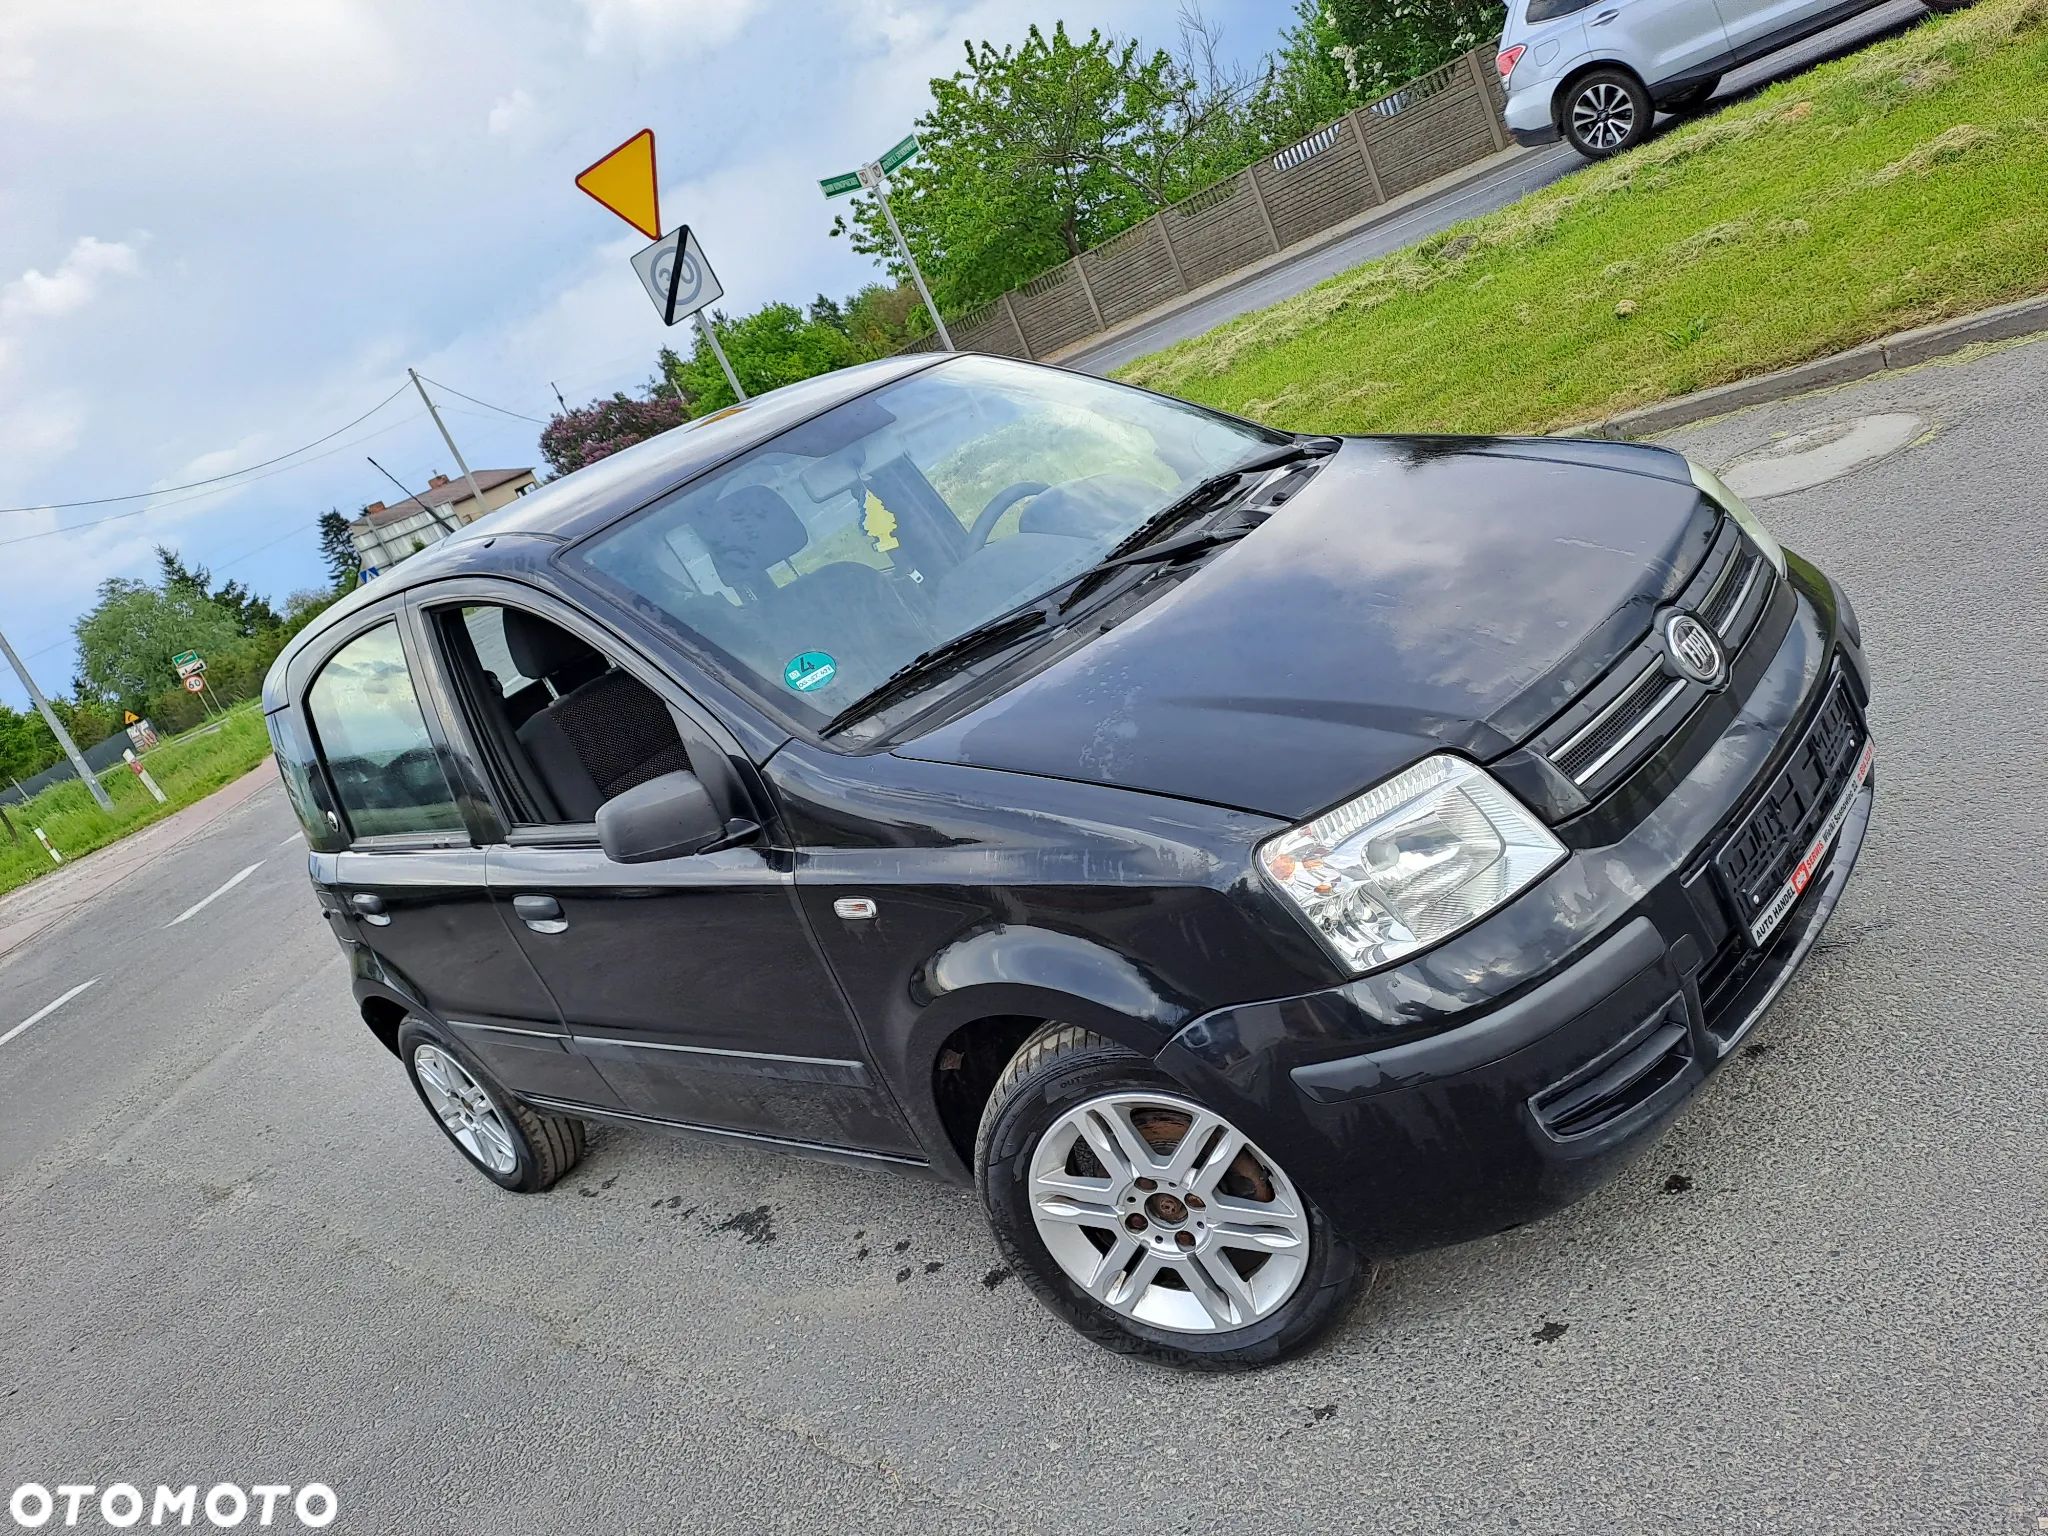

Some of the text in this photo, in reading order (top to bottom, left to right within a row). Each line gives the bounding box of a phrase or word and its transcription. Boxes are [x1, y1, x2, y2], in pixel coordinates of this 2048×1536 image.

[1681, 628, 1712, 668] FIAT
[800, 657, 815, 672] 4
[188, 679, 201, 689] 60
[1756, 917, 1774, 940] AUTO
[1774, 886, 1795, 919] HANDEL
[1807, 841, 1825, 869] SERWIS
